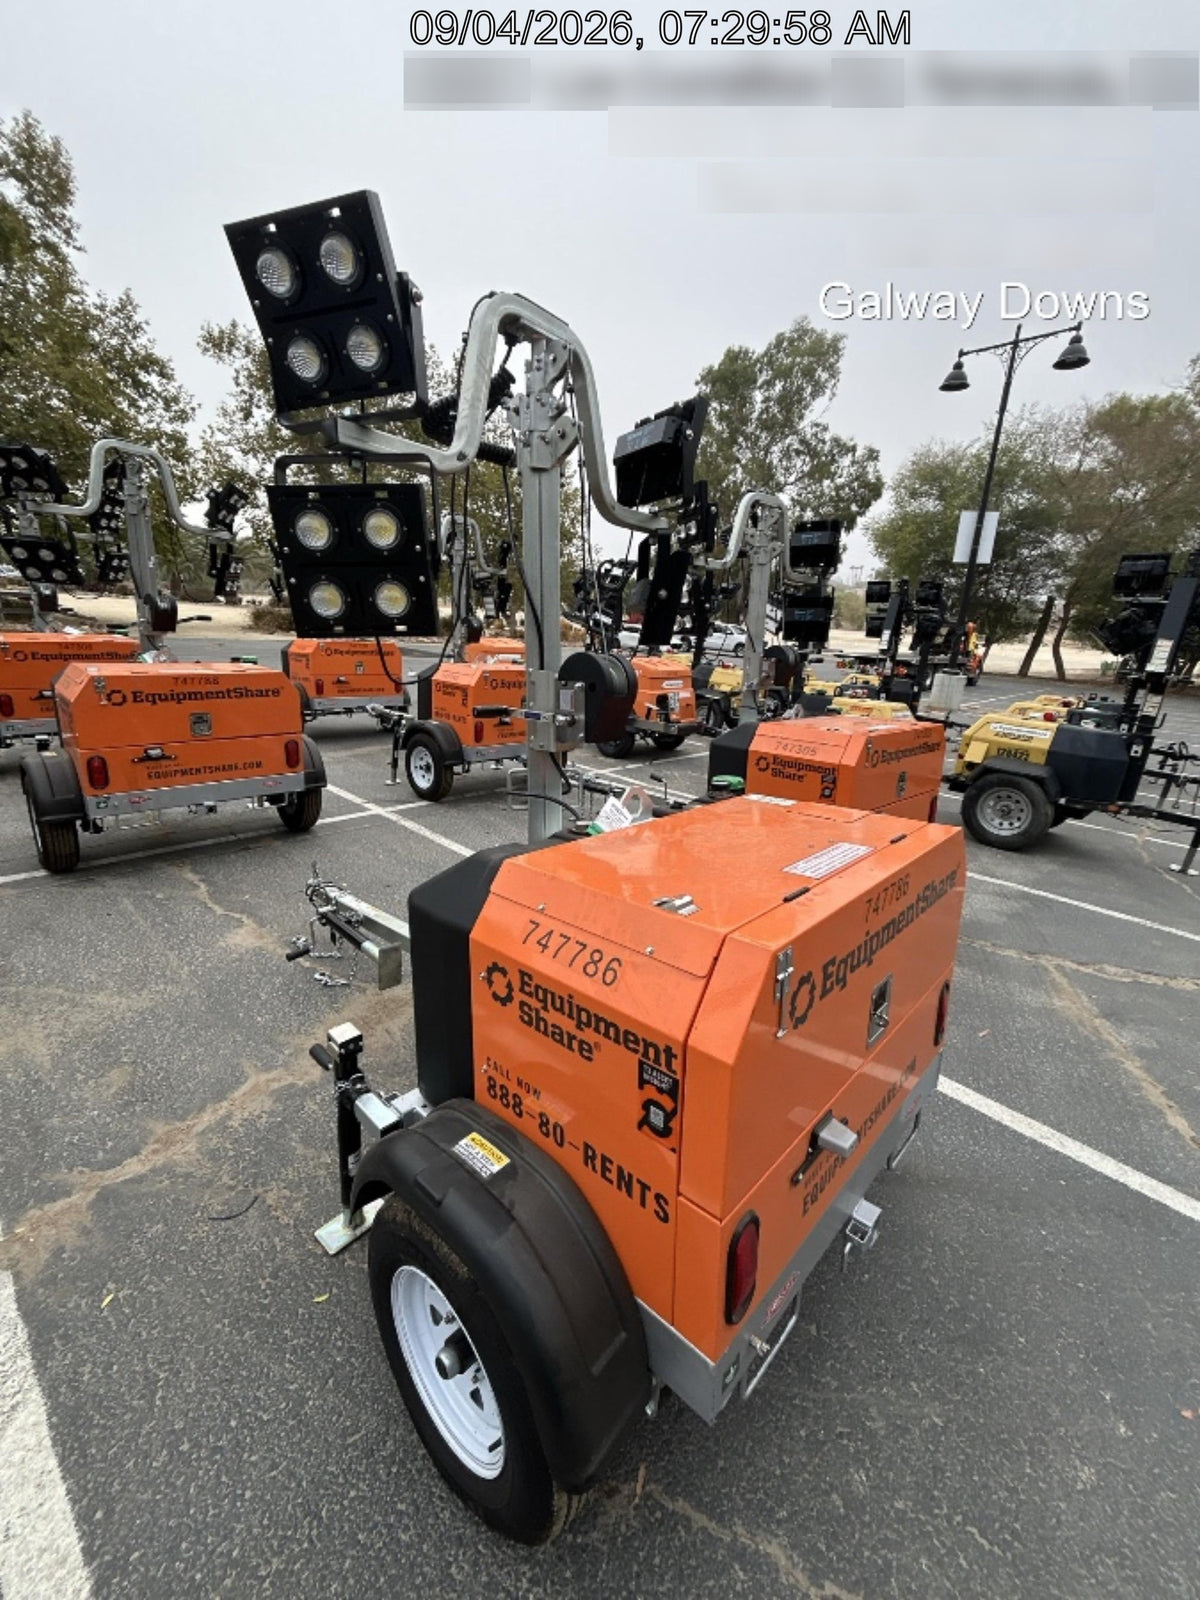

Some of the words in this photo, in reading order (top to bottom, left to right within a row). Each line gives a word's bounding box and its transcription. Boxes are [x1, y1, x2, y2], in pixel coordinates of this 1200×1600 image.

[131, 686, 280, 705] EquipmentShare
[771, 767, 805, 783] Share
[772, 755, 838, 776] Equipment
[865, 873, 910, 923] 747786
[522, 920, 623, 987] 747786
[819, 869, 958, 1001] EquipmentShare
[517, 968, 679, 1076] Equipment
[518, 1001, 595, 1062] Share
[486, 1056, 511, 1082] CALL
[516, 1077, 541, 1100] NOW
[486, 1075, 670, 1224] 888-80-RENTS
